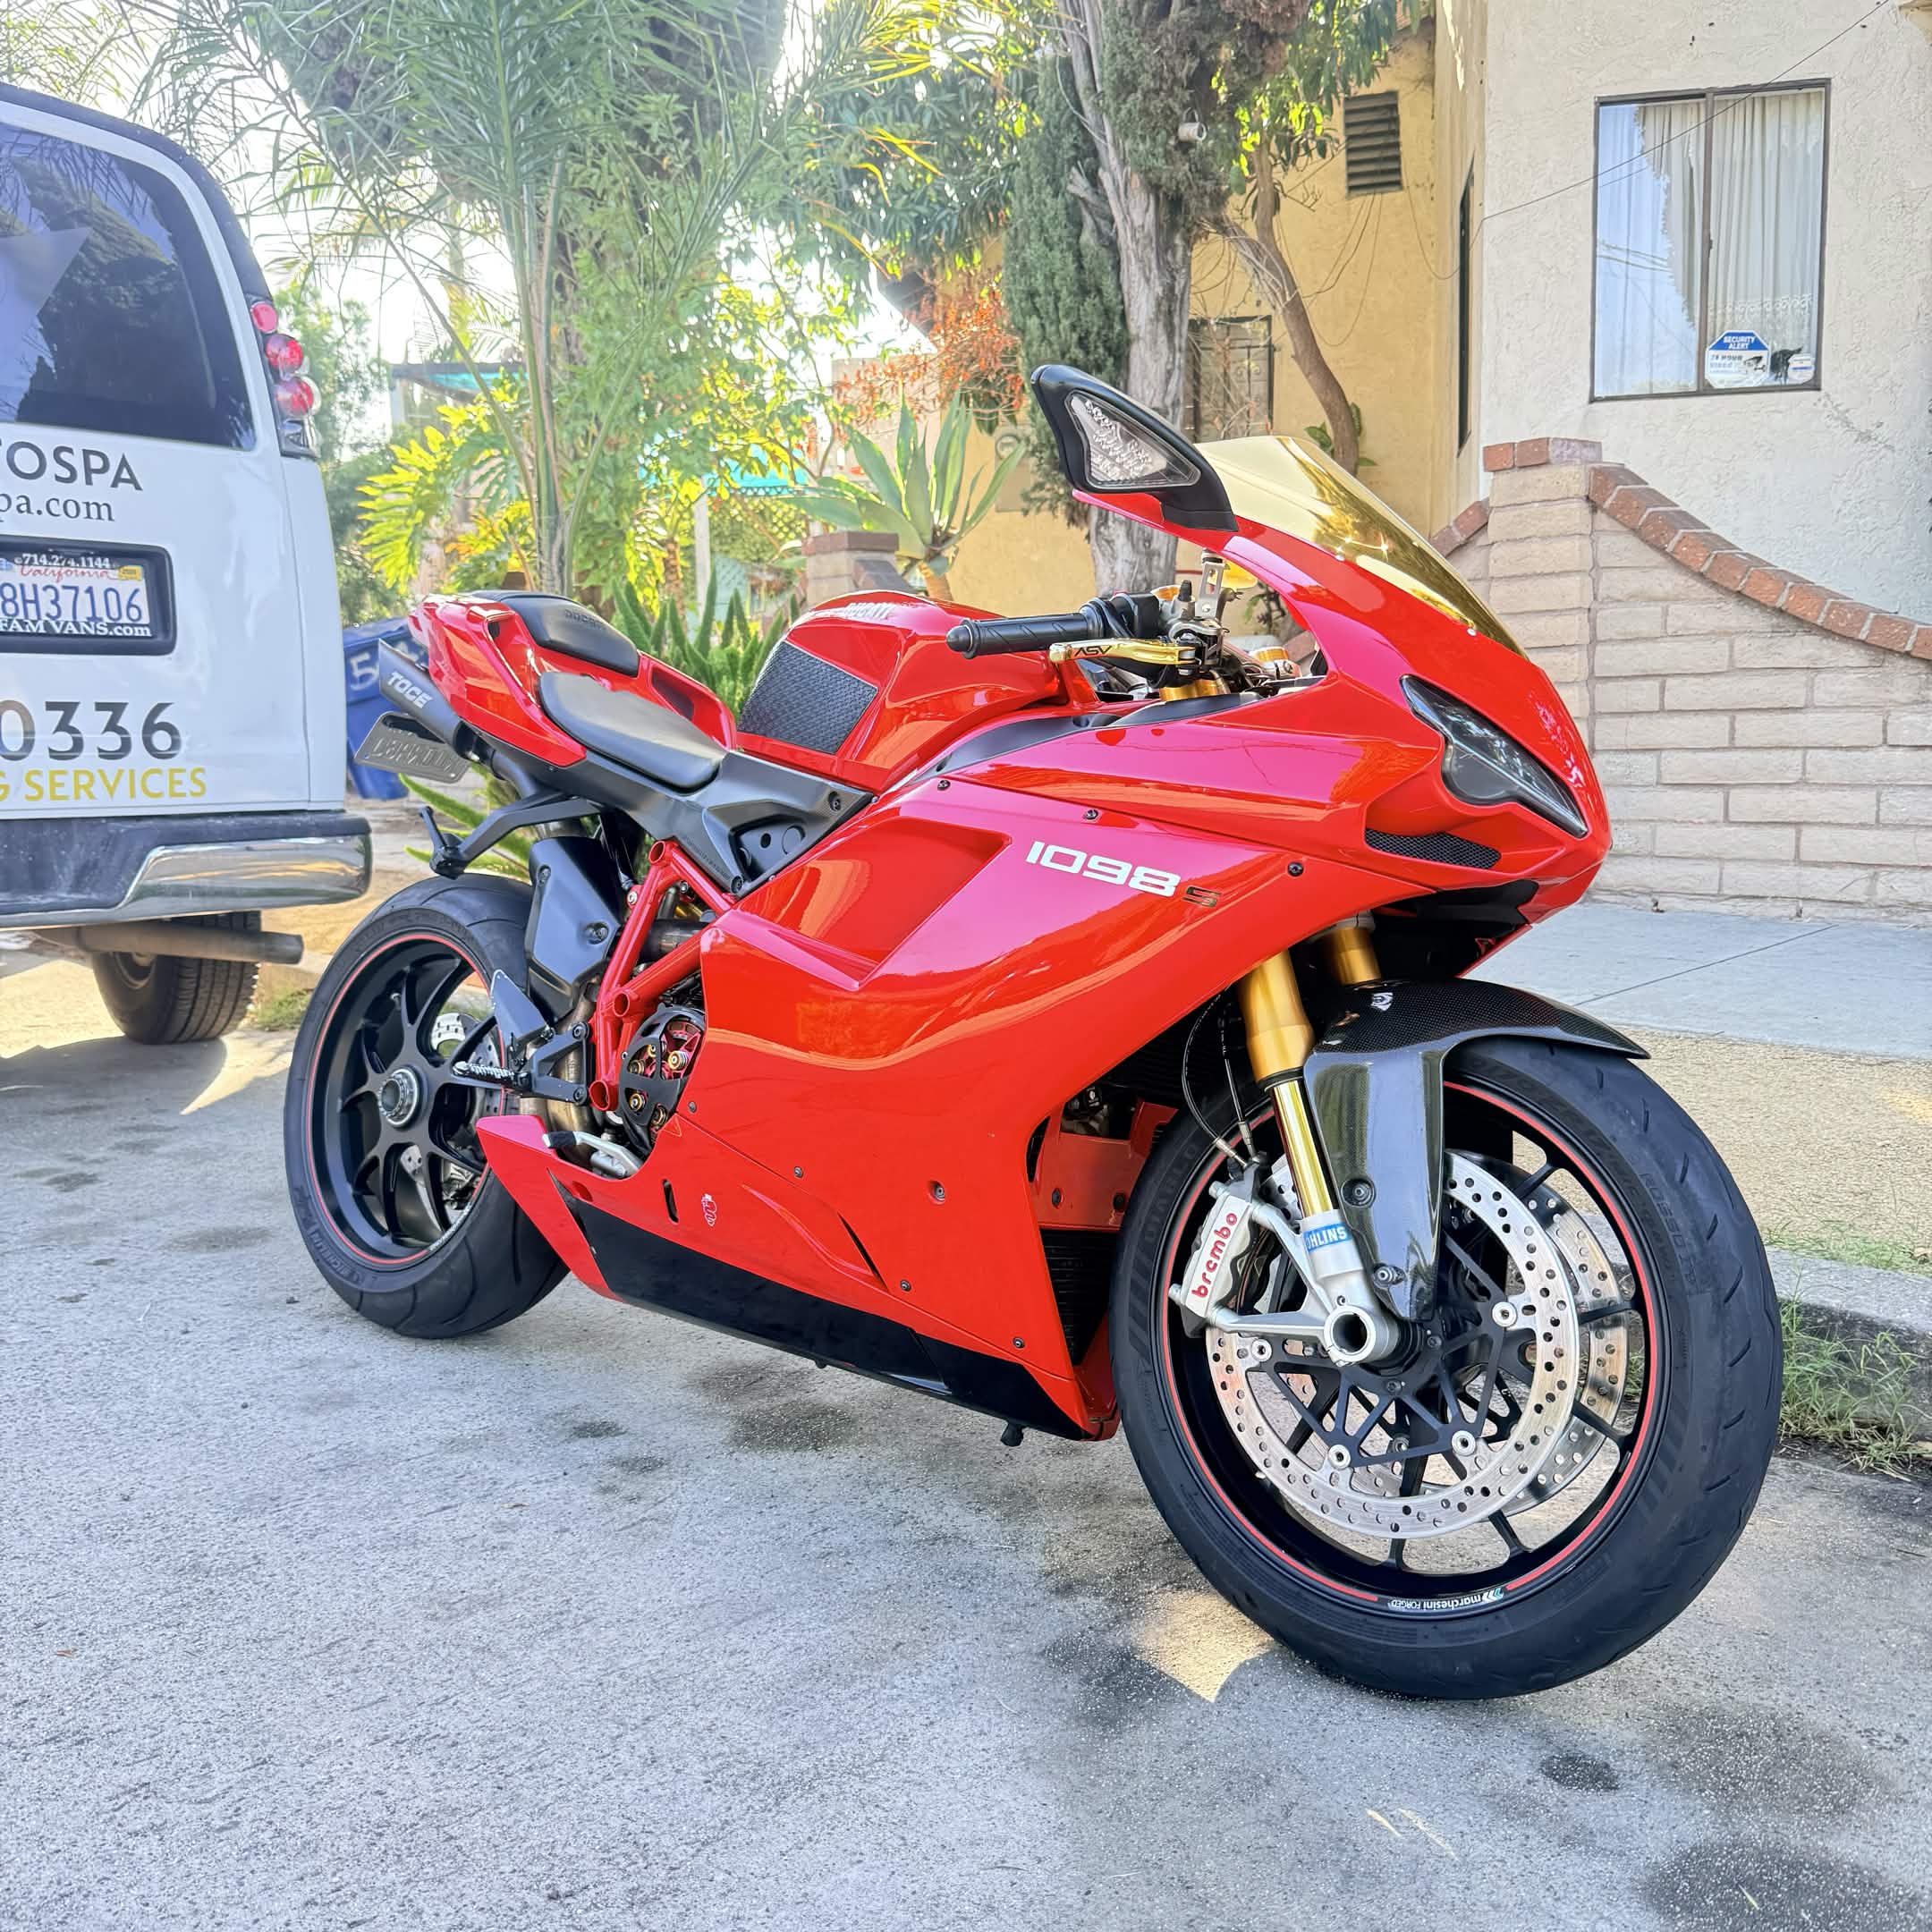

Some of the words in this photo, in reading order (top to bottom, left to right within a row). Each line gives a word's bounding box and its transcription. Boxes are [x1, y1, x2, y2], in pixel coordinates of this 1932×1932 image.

[1723, 335, 1755, 343] SECURITY
[0, 439, 143, 491] OSPA
[0, 582, 142, 623] 8H37106
[49, 621, 152, 637] VANS.com
[1074, 645, 1113, 657] ASV
[387, 671, 433, 708] TOCE
[0, 699, 182, 761] 0336
[24, 767, 207, 802] SERVICES
[1026, 841, 1181, 897] 1098
[1182, 885, 1222, 908] S
[1191, 1213, 1238, 1299] brembo
[1391, 1599, 1421, 1609] FORGED
[1423, 1594, 1481, 1611] marchesini
